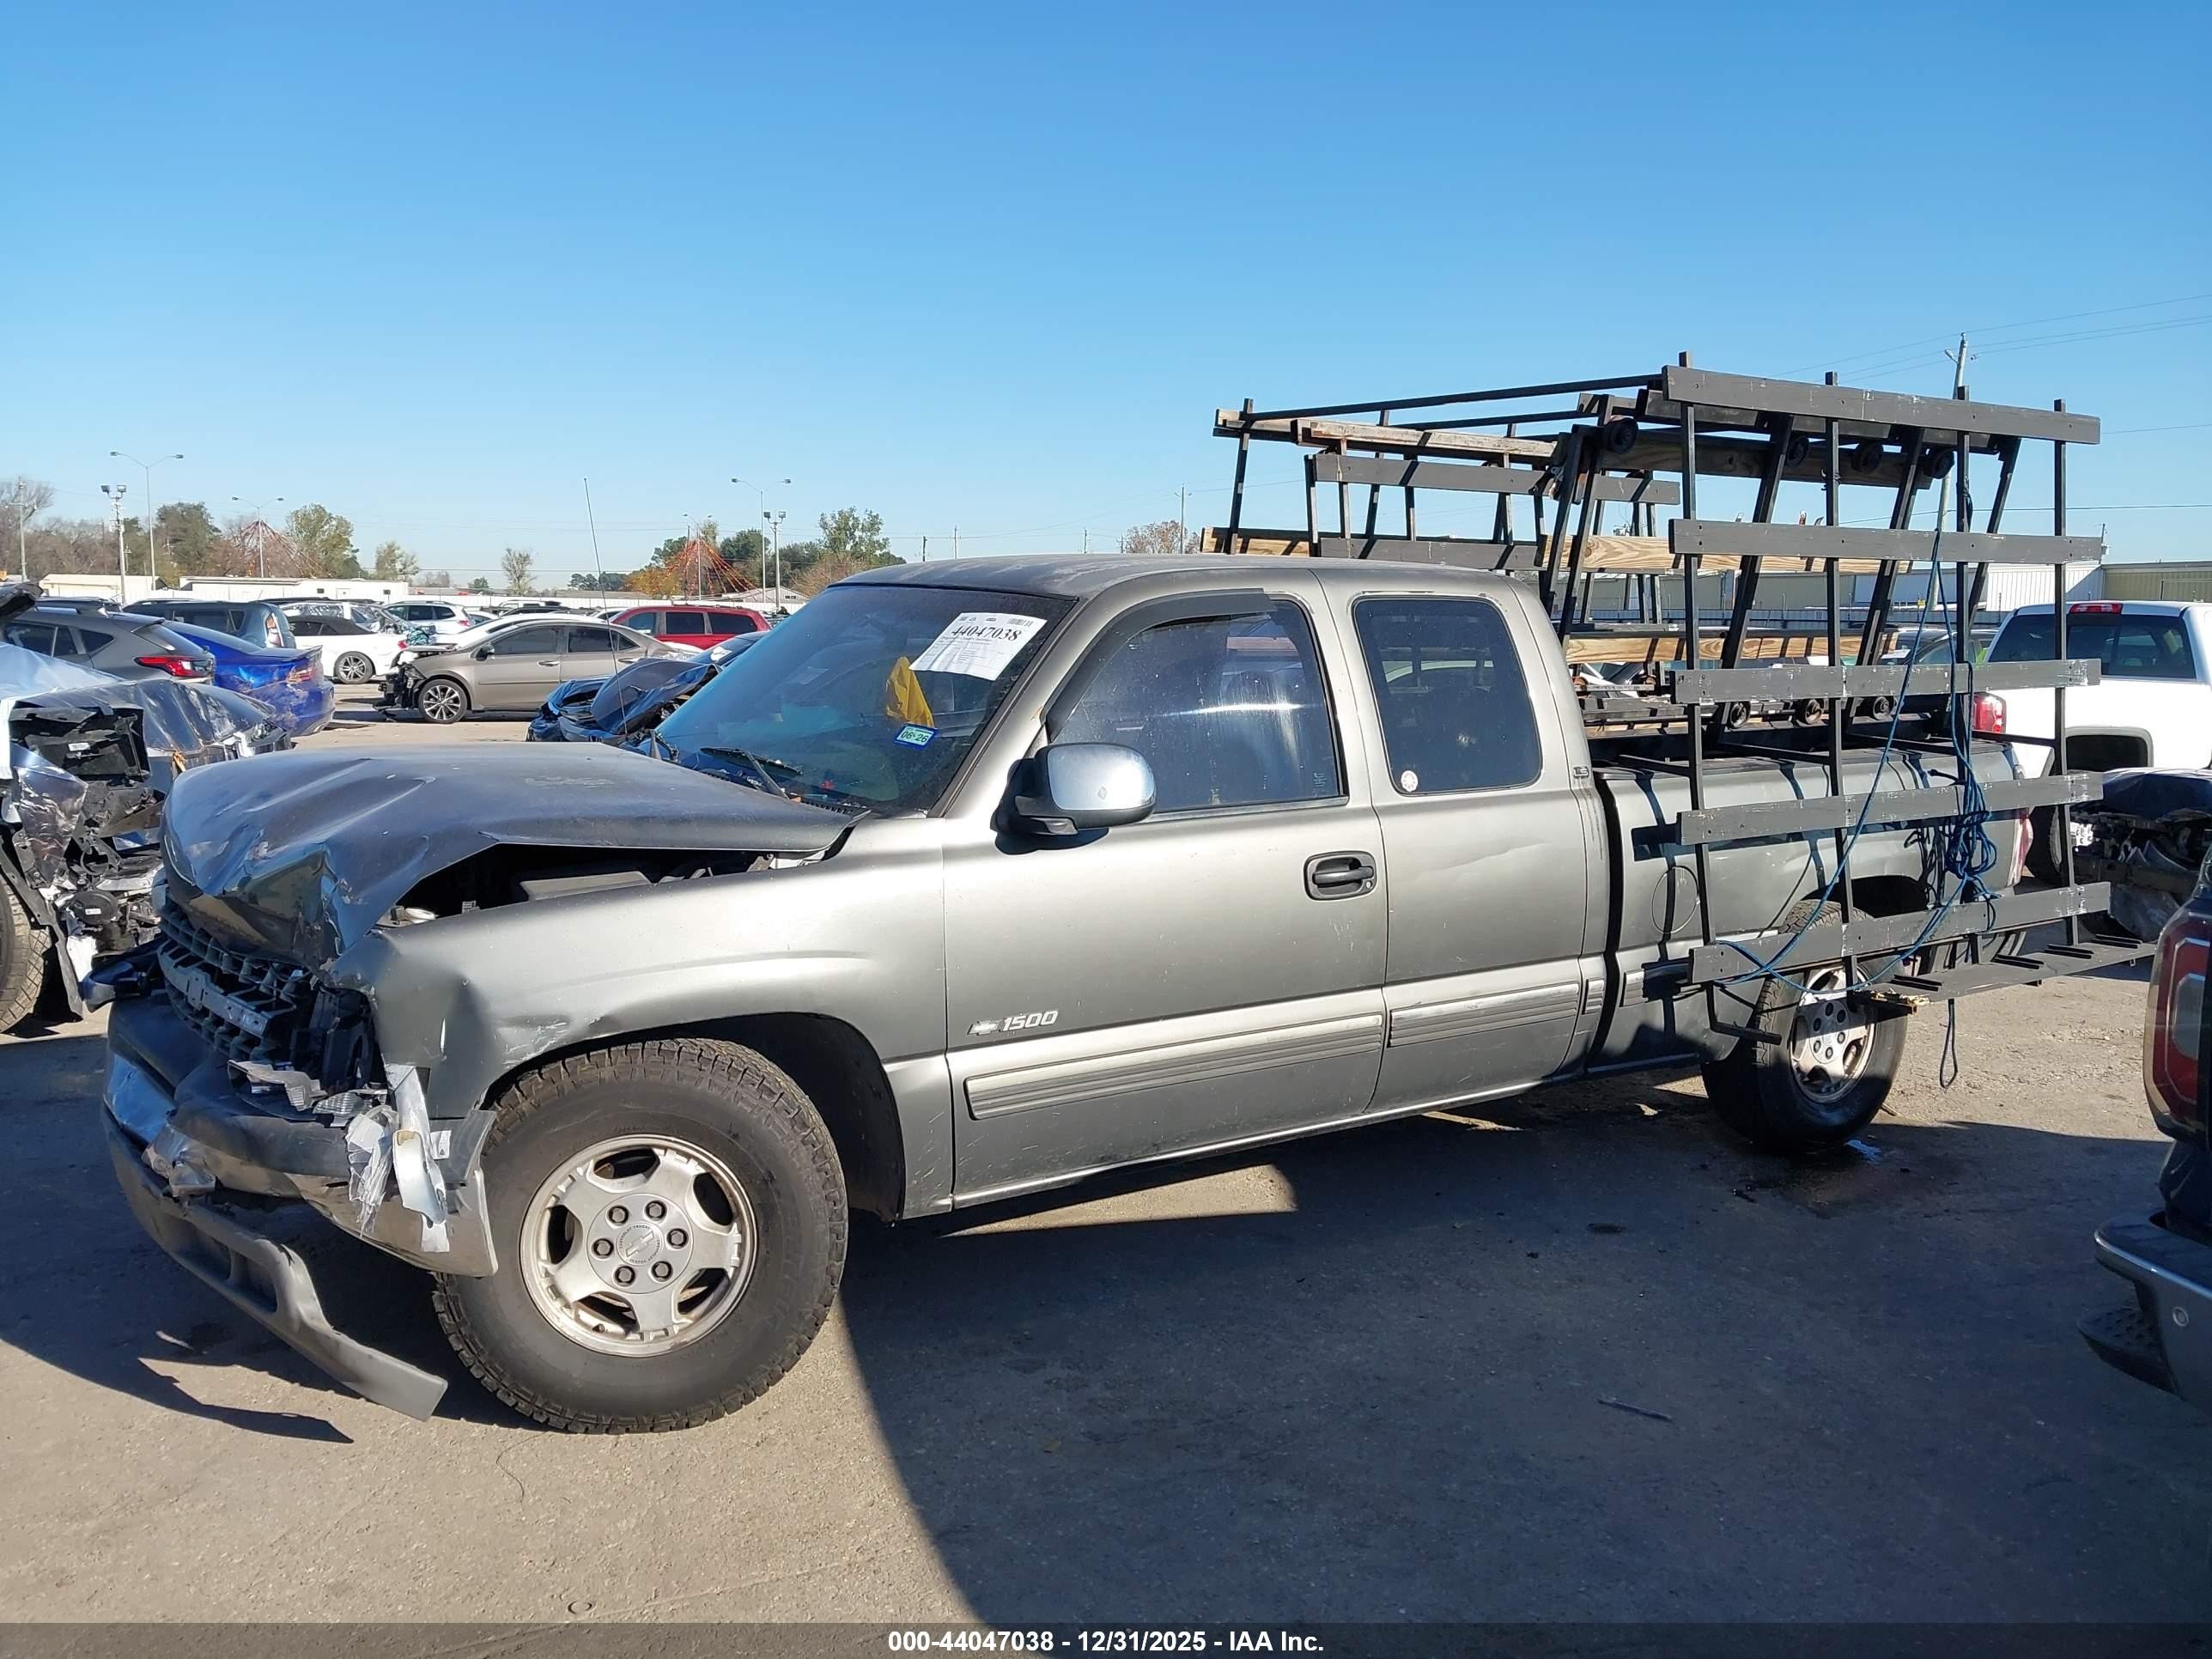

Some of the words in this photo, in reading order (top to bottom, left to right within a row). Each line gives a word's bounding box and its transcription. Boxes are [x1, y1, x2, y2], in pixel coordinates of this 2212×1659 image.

[951, 626, 1022, 641] 44047038
[915, 733, 928, 743] 26
[1002, 1010, 1058, 1031] 1500
